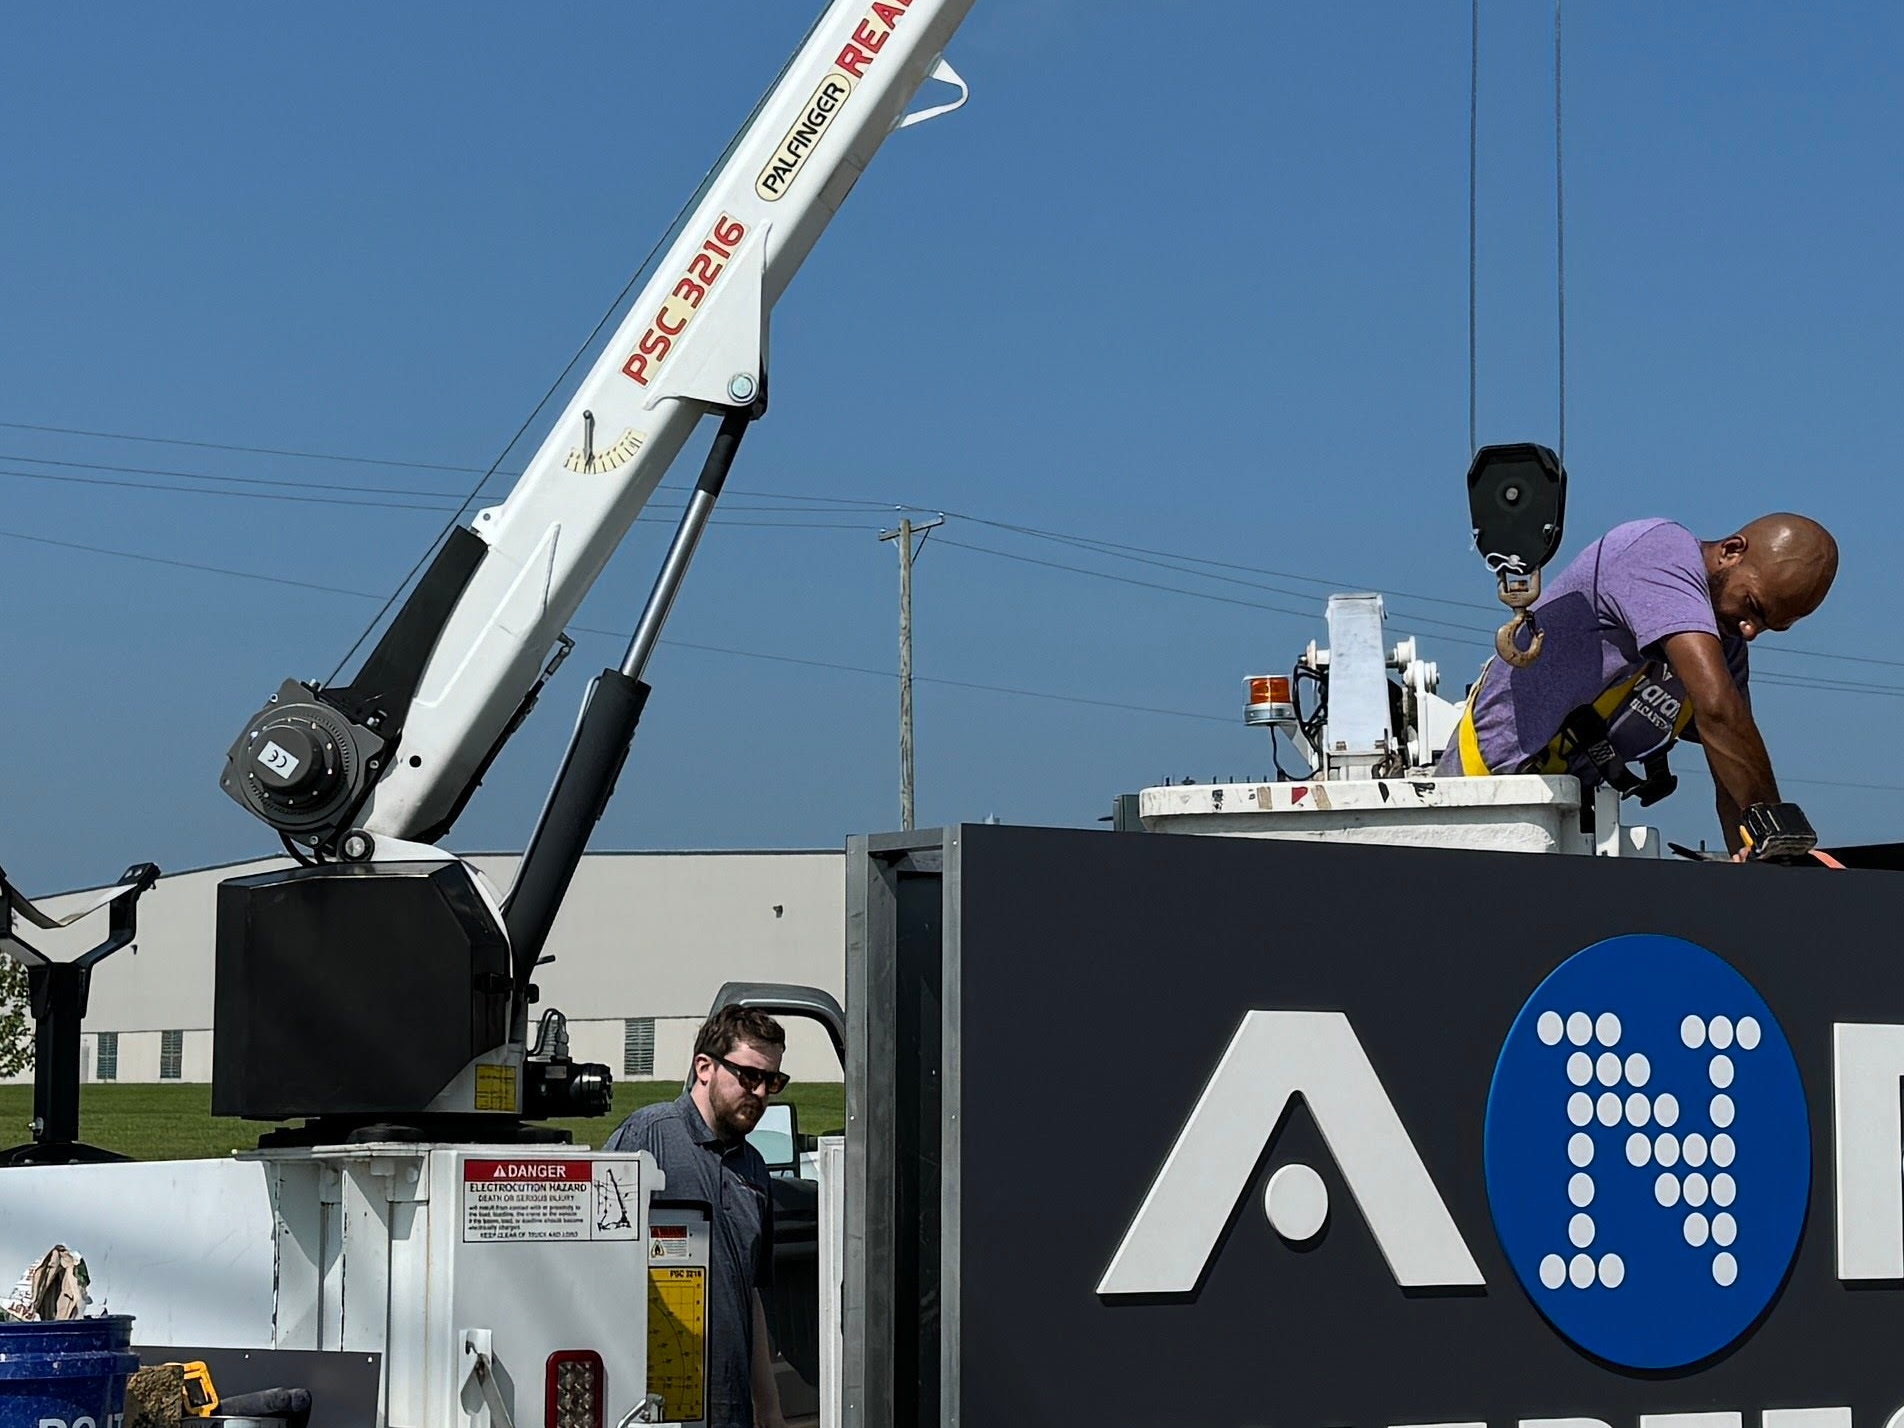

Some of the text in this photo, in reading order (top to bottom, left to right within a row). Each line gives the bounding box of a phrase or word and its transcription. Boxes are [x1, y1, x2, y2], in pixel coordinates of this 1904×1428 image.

[761, 81, 846, 195] PALFINGER
[621, 215, 745, 387] PSC 3216
[470, 1183, 587, 1193] ELECTROCUTION HAZARD
[508, 1165, 566, 1178] DANGER
